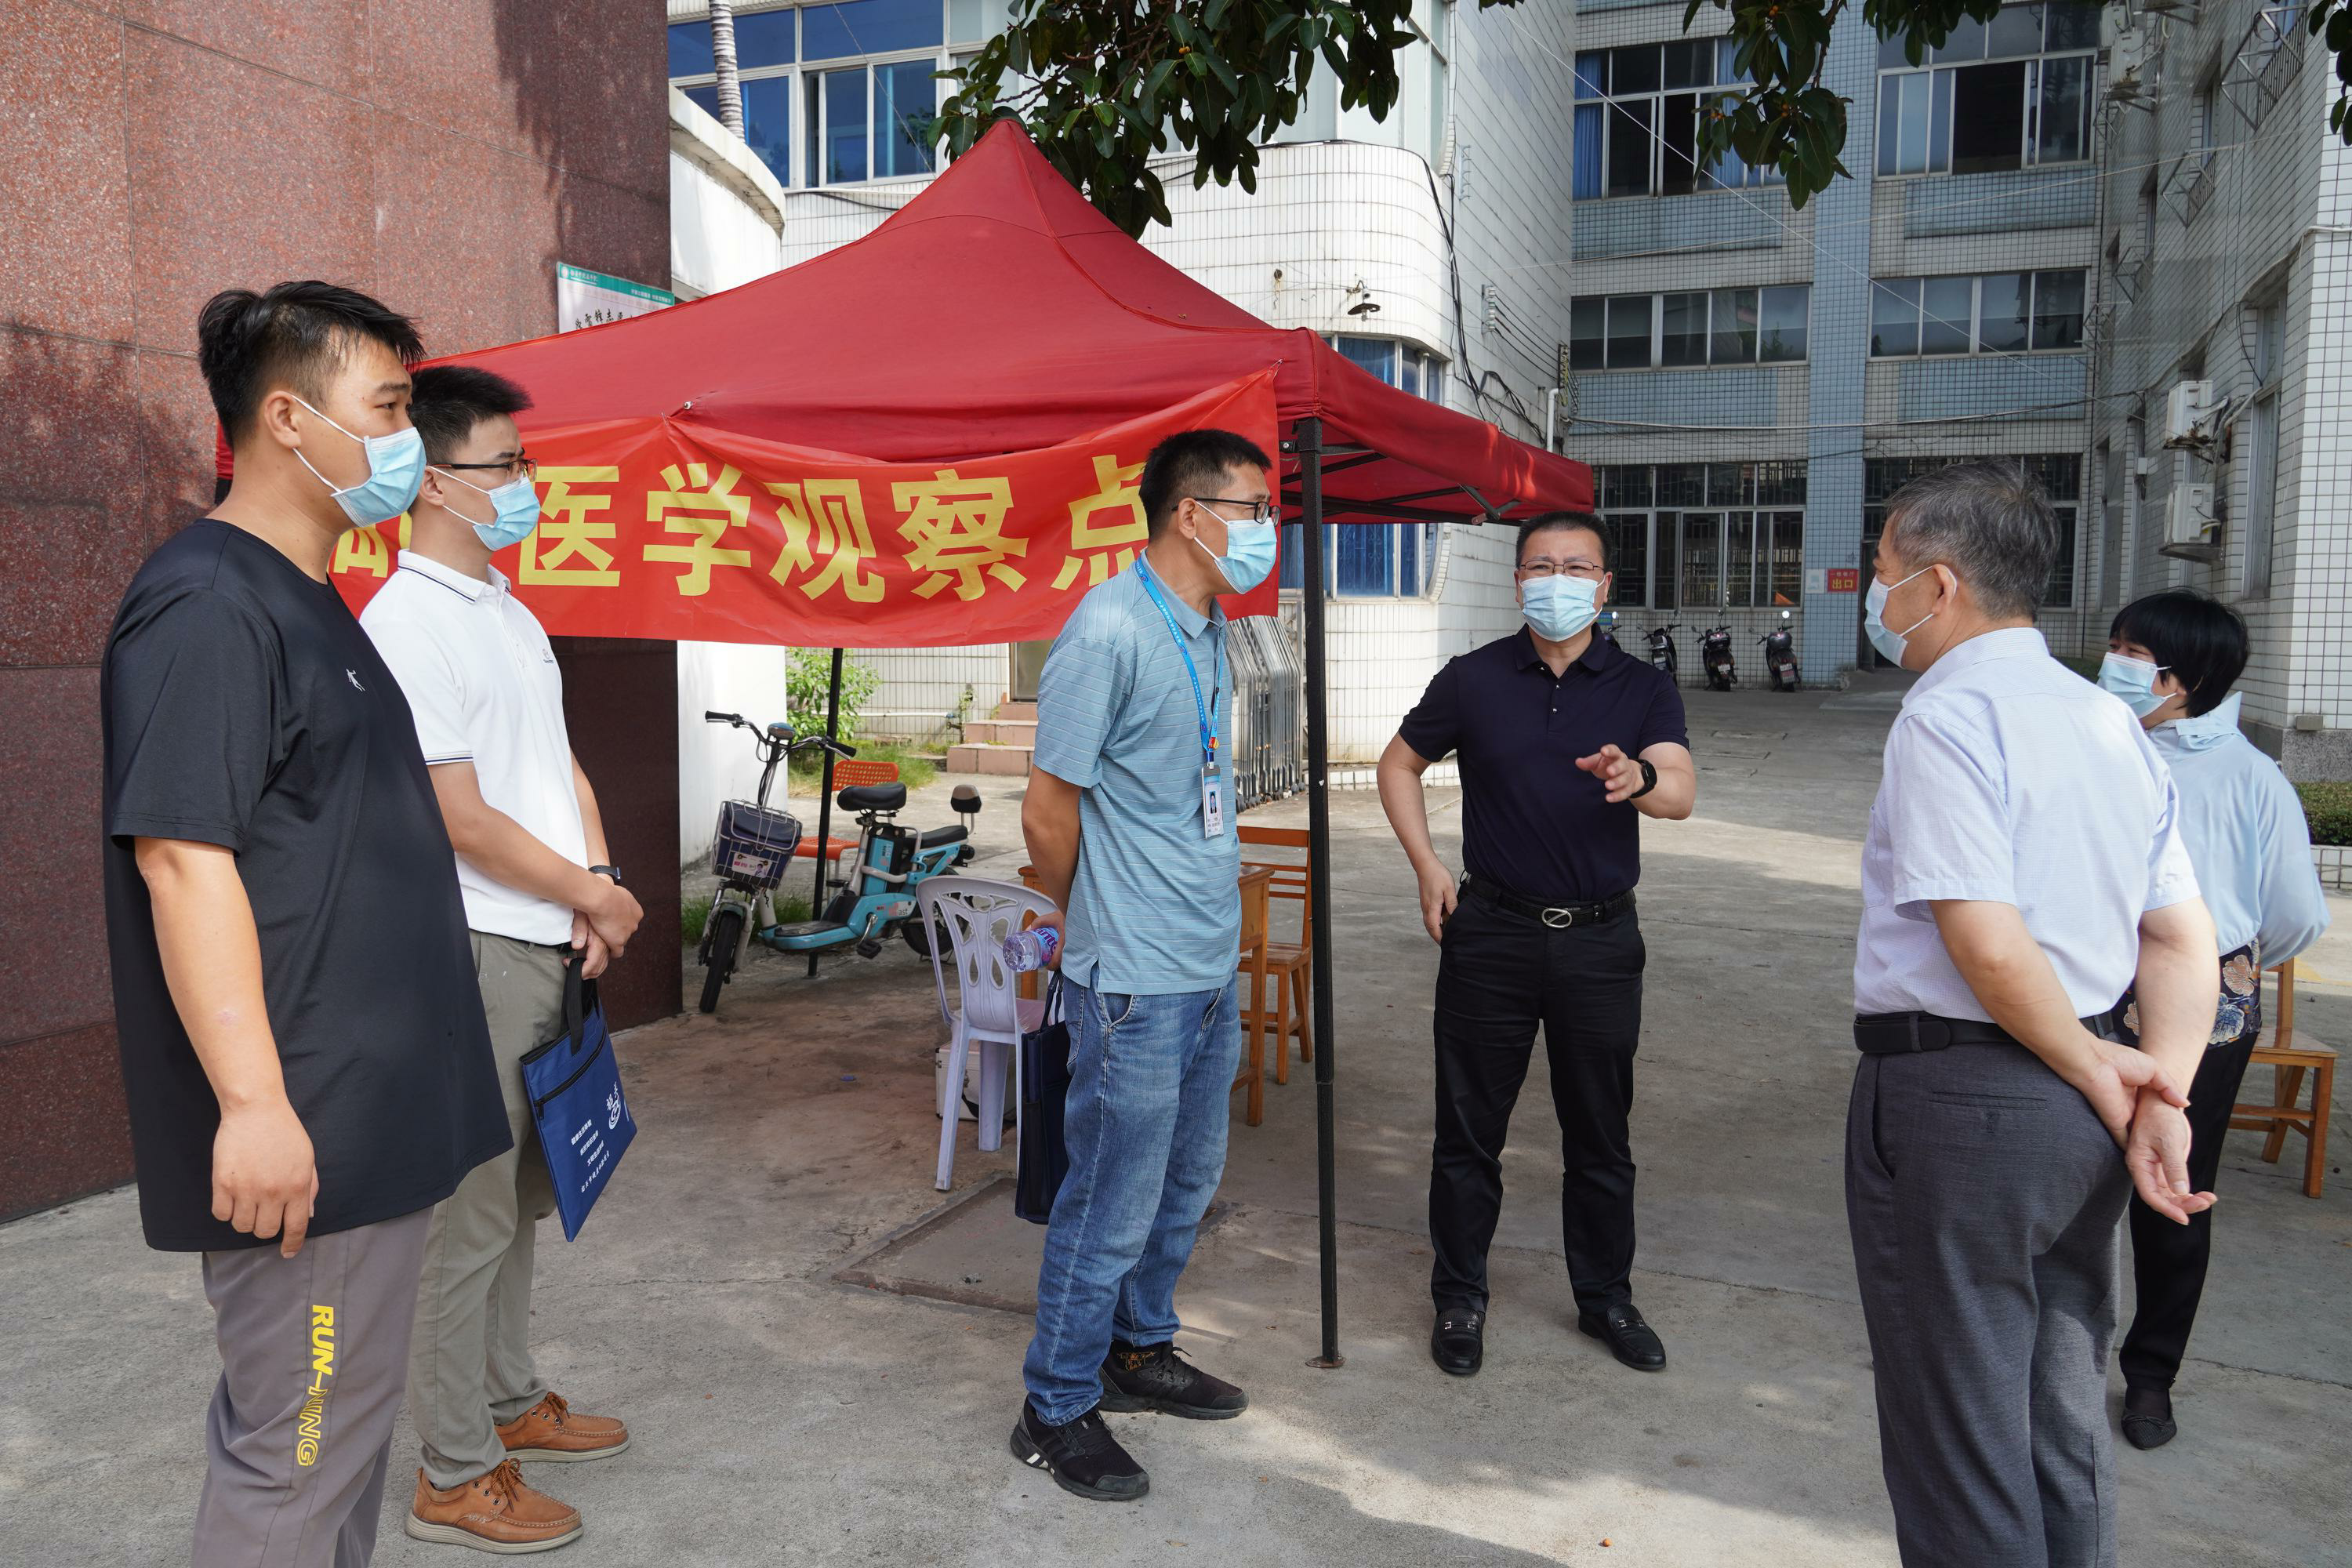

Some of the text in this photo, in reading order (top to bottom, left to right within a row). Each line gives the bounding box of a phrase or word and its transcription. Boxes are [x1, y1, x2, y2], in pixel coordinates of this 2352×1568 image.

[333, 455, 1149, 603] 医学观察点
[1831, 579, 1853, 590] 出口
